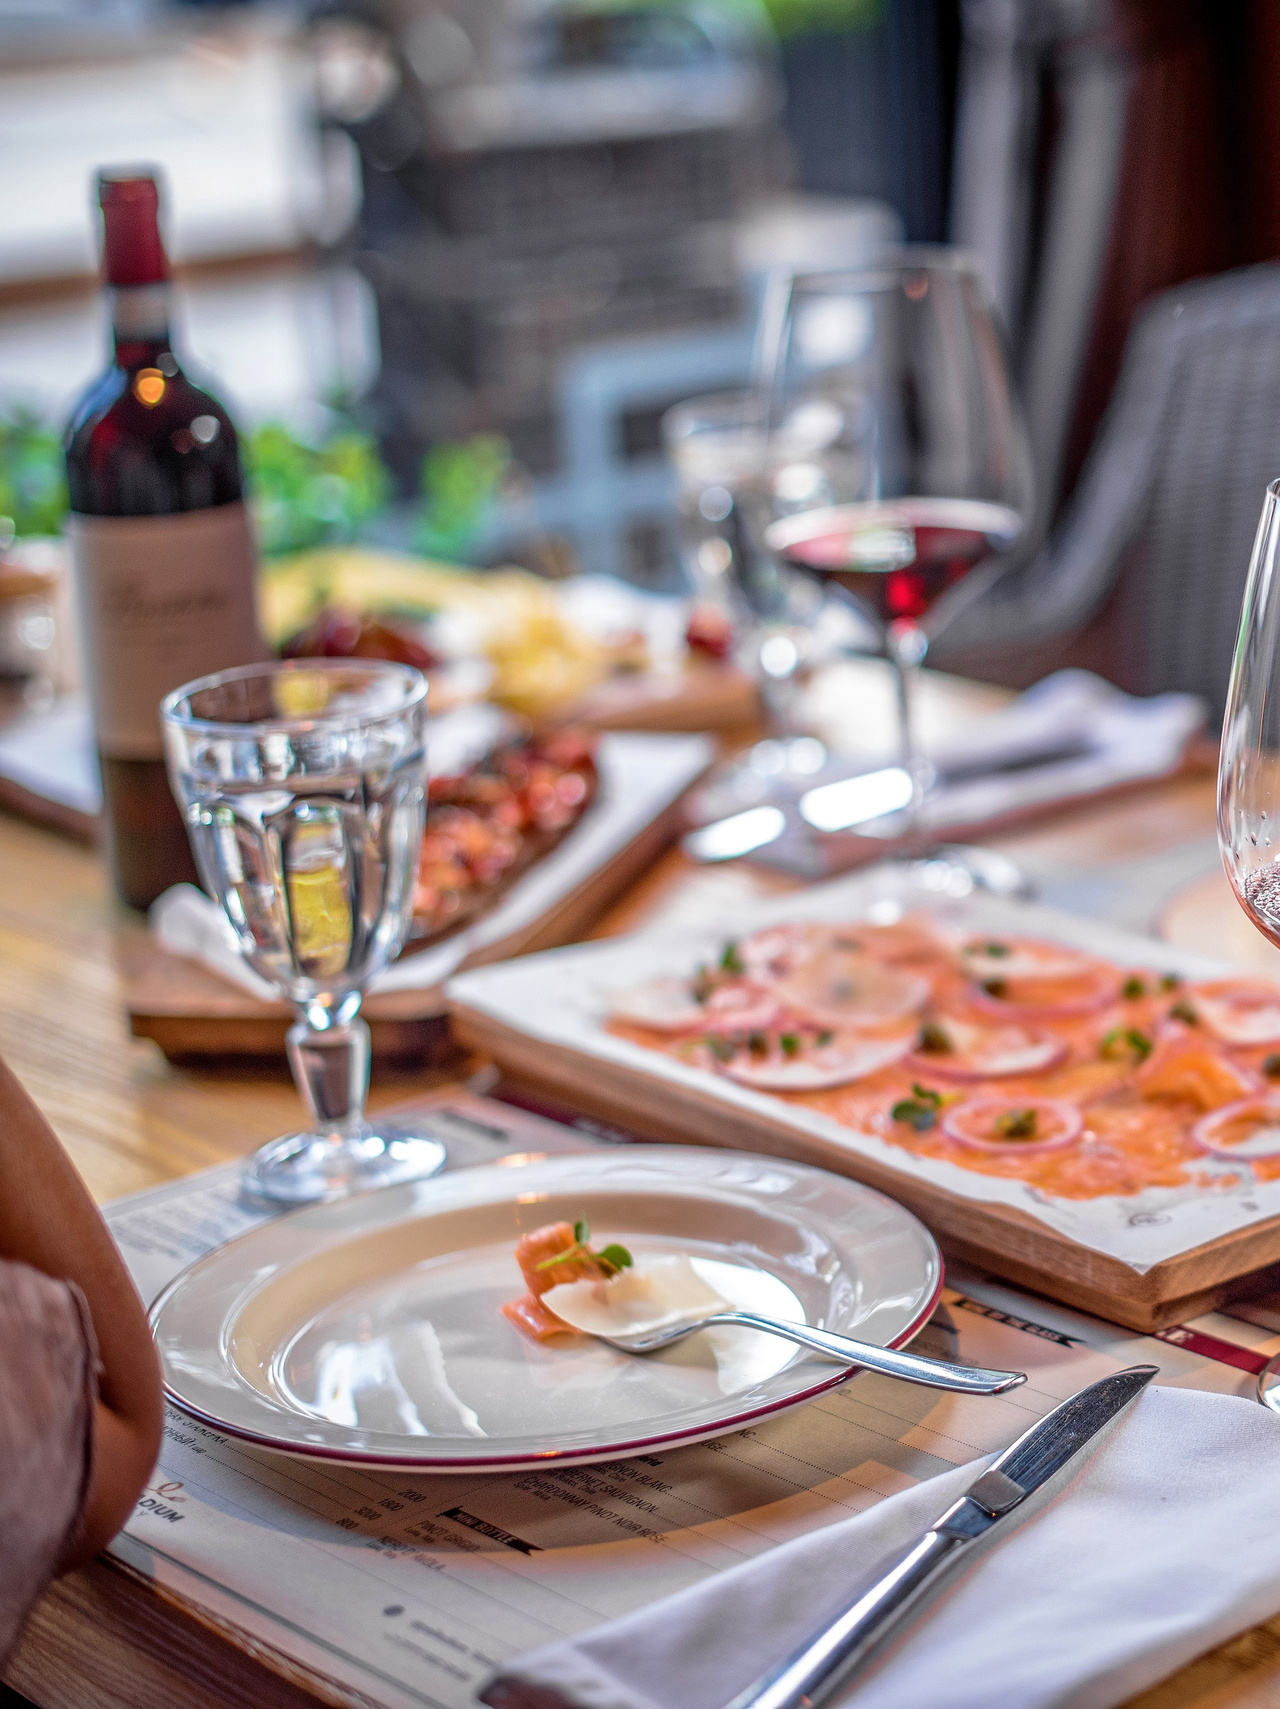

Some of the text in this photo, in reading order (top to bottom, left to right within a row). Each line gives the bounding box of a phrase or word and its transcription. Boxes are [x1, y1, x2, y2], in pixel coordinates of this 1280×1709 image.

[638, 1475, 673, 1493] BLANC
[138, 1497, 186, 1523] DIUM
[522, 1475, 592, 1507] CHARDONNAY
[584, 1503, 619, 1520] PINOT
[613, 1516, 643, 1532] NOIR
[600, 1484, 660, 1513] SAUVIGNON
[475, 1521, 517, 1544] BOTTLE
